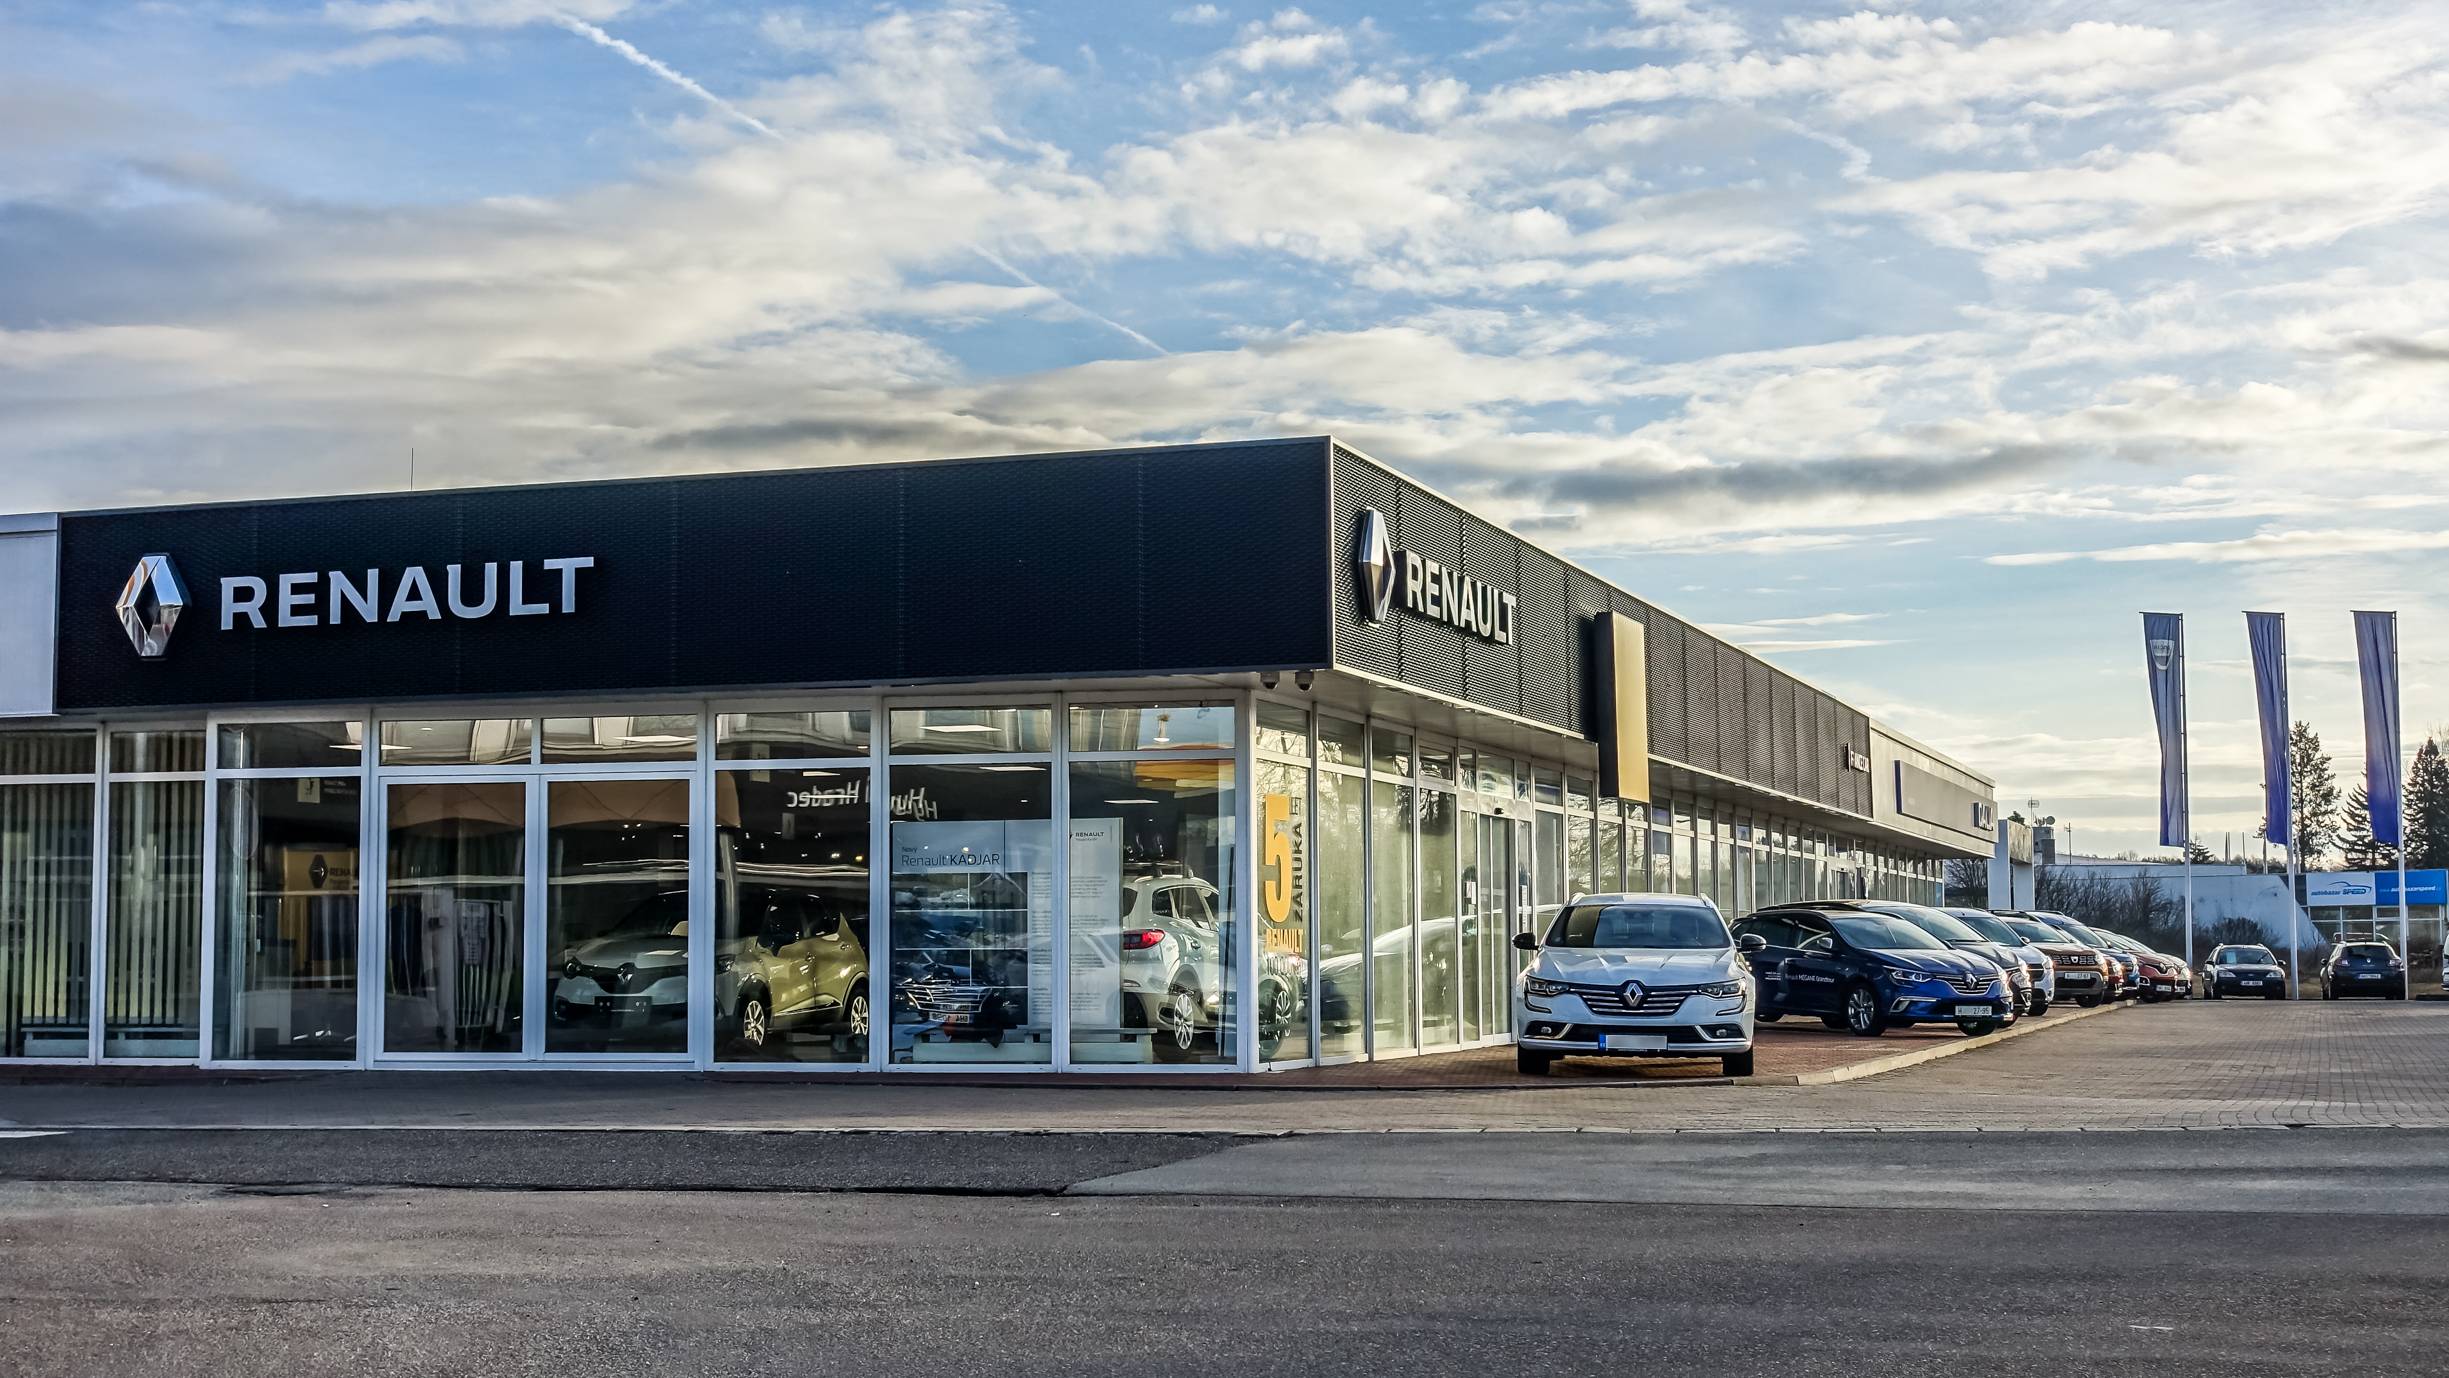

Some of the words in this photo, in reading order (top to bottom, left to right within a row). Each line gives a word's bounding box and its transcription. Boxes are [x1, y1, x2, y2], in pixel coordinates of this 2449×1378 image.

[220, 556, 595, 630] RENAULT
[1405, 549, 1517, 645] RENAULT
[901, 854, 947, 867] Renault
[949, 853, 1001, 866] KADJAR
[1265, 794, 1292, 922] 5
[1266, 928, 1304, 953] RENAULT
